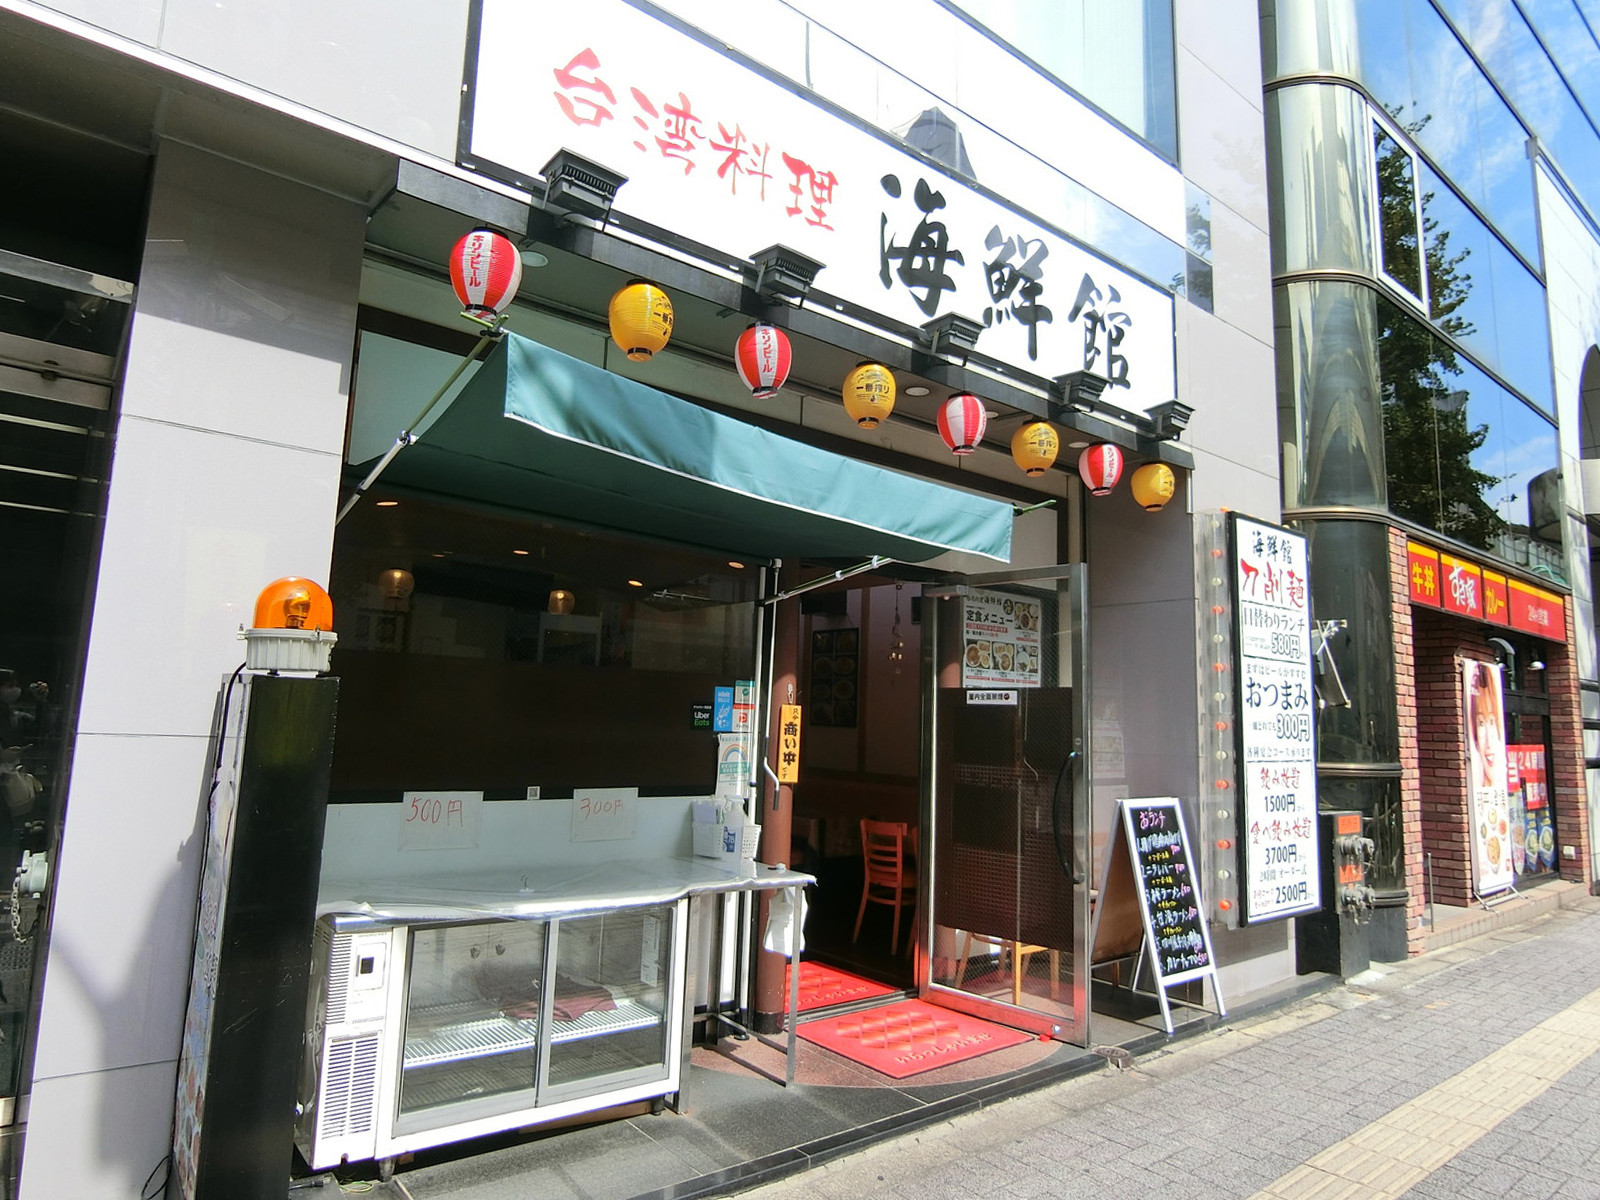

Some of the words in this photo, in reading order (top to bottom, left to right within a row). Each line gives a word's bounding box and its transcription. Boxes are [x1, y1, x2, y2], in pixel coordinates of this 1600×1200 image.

[553, 47, 838, 232] 台湾料理
[879, 173, 1133, 390] 海鮮館
[469, 235, 484, 287] キリンビール
[761, 329, 773, 373] キリンビール
[1252, 530, 1292, 564] 海鮮館
[1240, 558, 1305, 608] 刀削麺
[1412, 562, 1435, 596] 牛丼
[1448, 562, 1476, 613] すき家
[966, 609, 1013, 625] 定食メニュー
[1486, 587, 1505, 614] カレー
[1246, 676, 1308, 711] おつまみ
[783, 721, 798, 766] 商い中
[1277, 713, 1310, 742] 300円
[407, 797, 463, 827] 500円
[1264, 794, 1295, 813] 1500円
[1265, 844, 1297, 865] 3700円
[1275, 882, 1307, 904] 2500円
[895, 1031, 993, 1064] いらっしゃいませ
